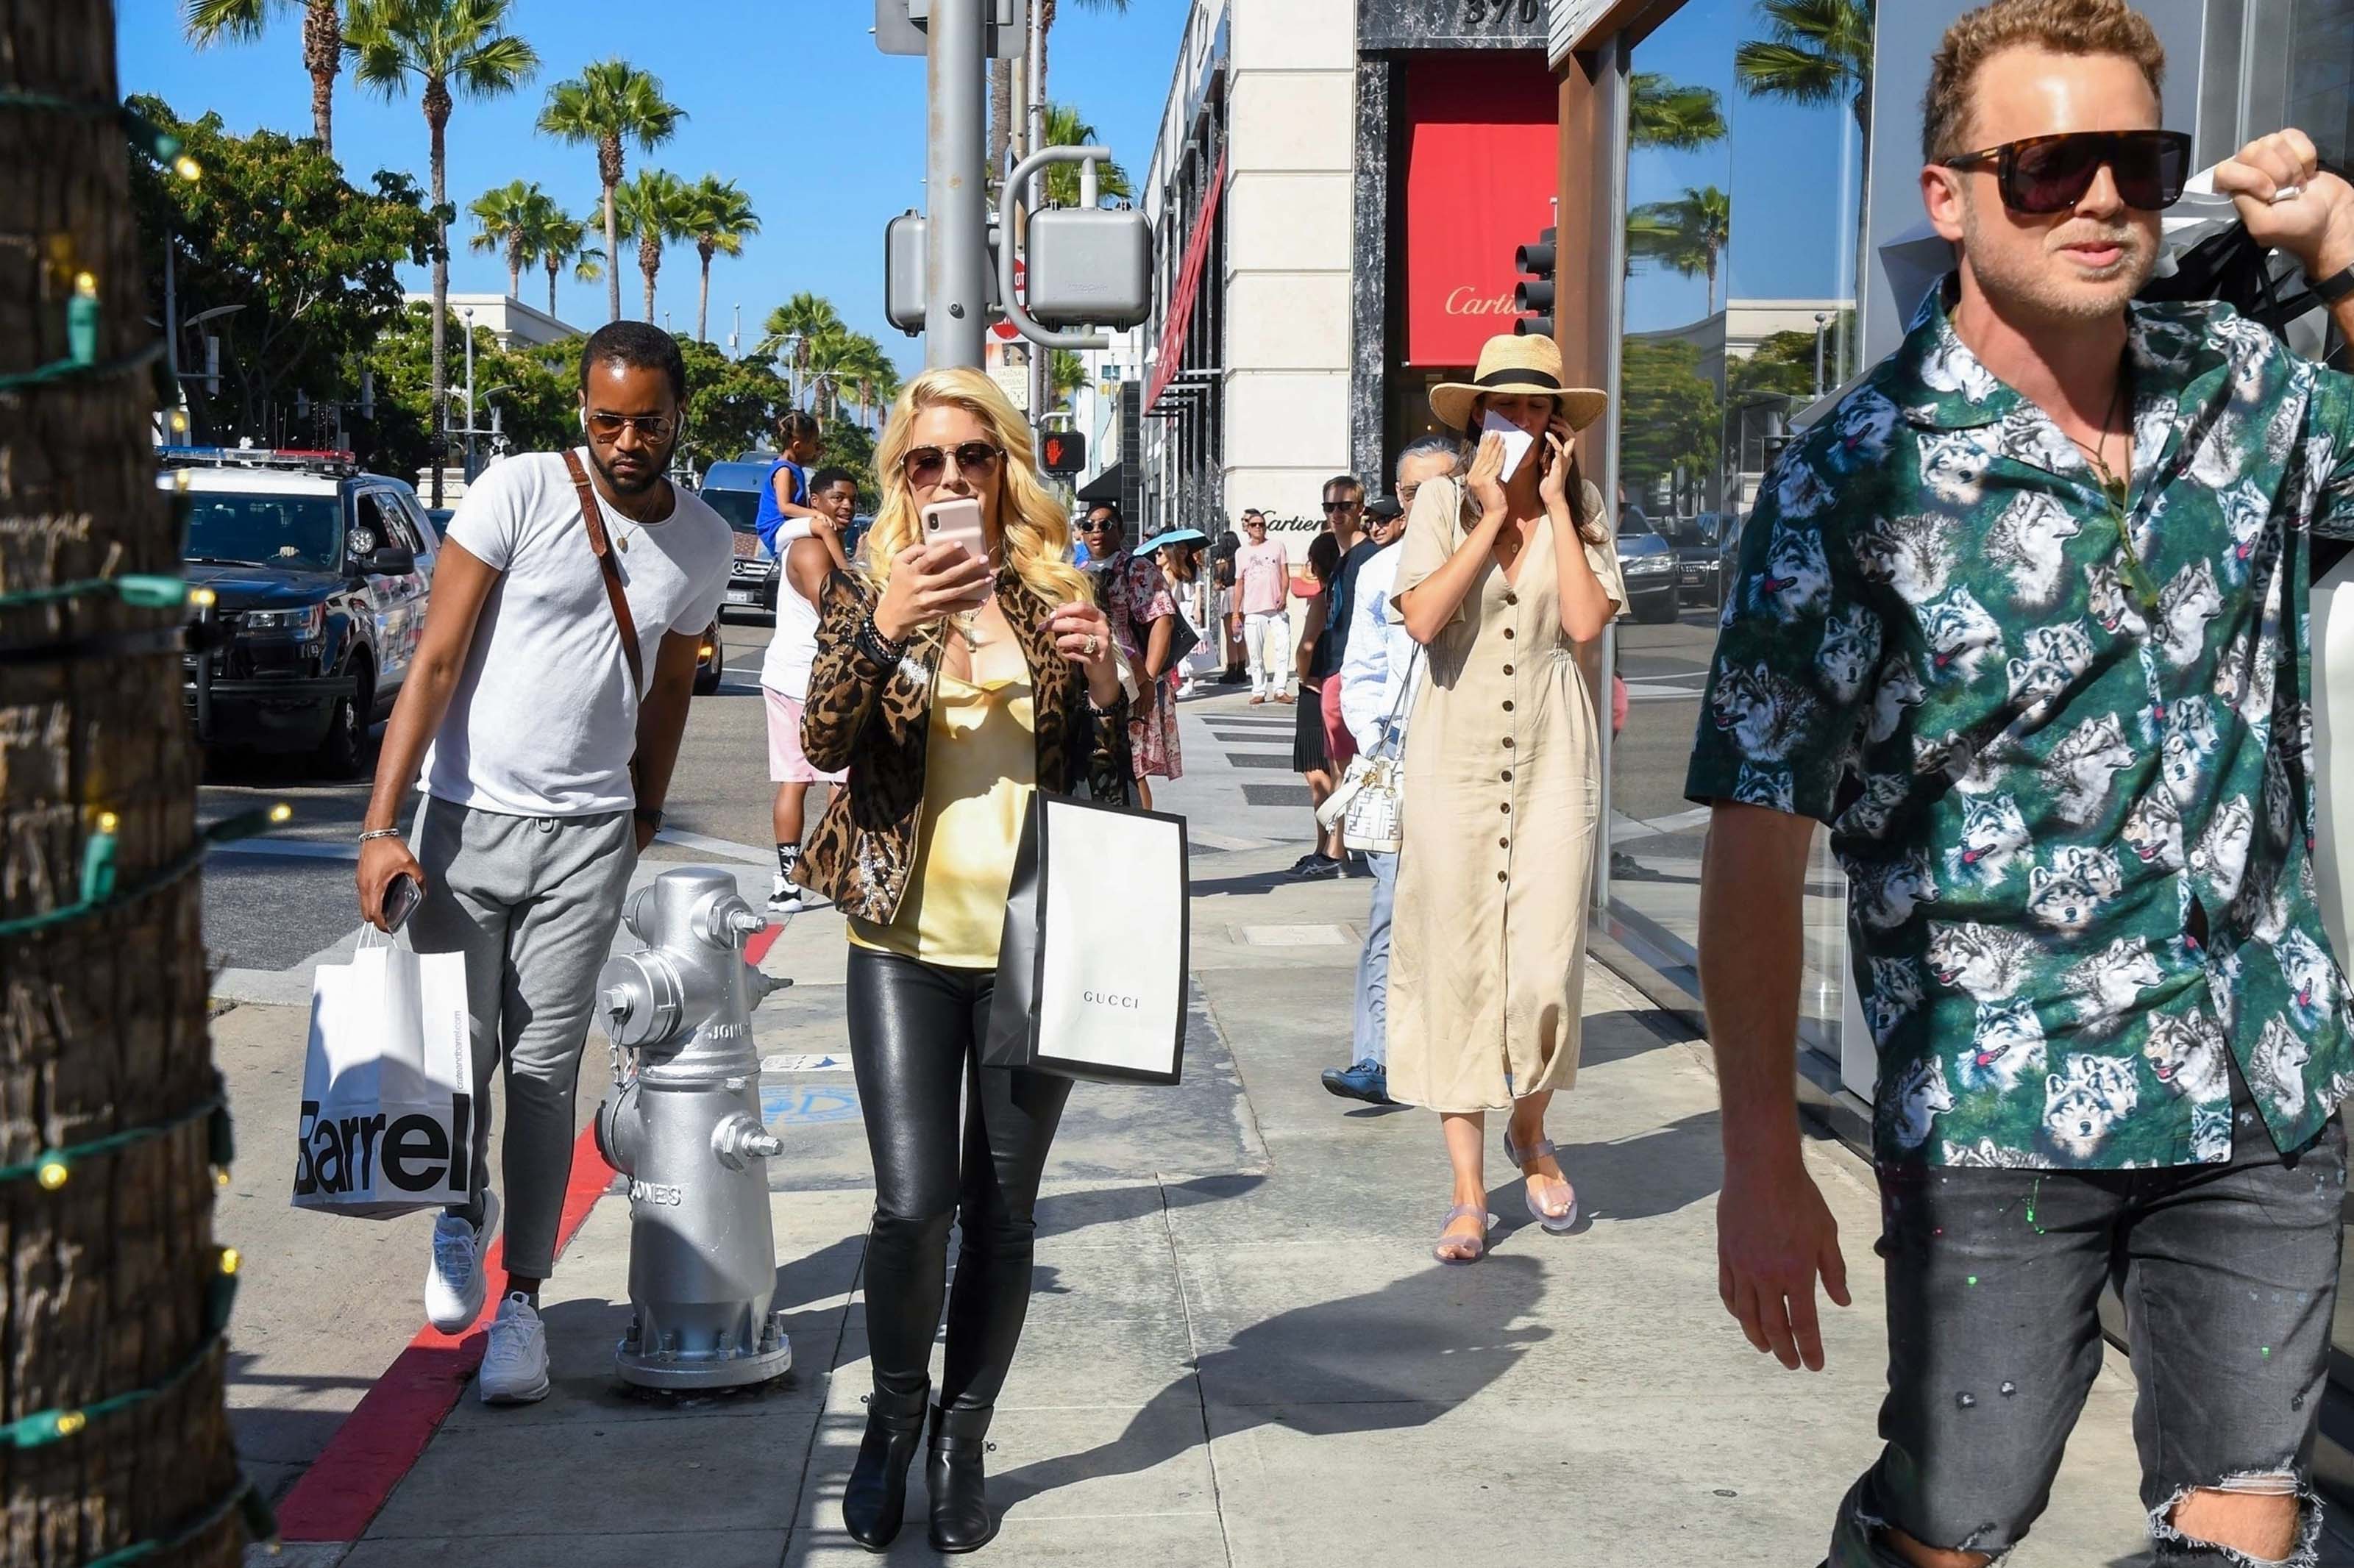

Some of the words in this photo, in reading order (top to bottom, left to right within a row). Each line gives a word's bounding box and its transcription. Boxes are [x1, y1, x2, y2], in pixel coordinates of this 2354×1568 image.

[1446, 285, 1529, 315] Carti
[1084, 991, 1138, 1008] GUCCI
[294, 1093, 470, 1196] Barrel
